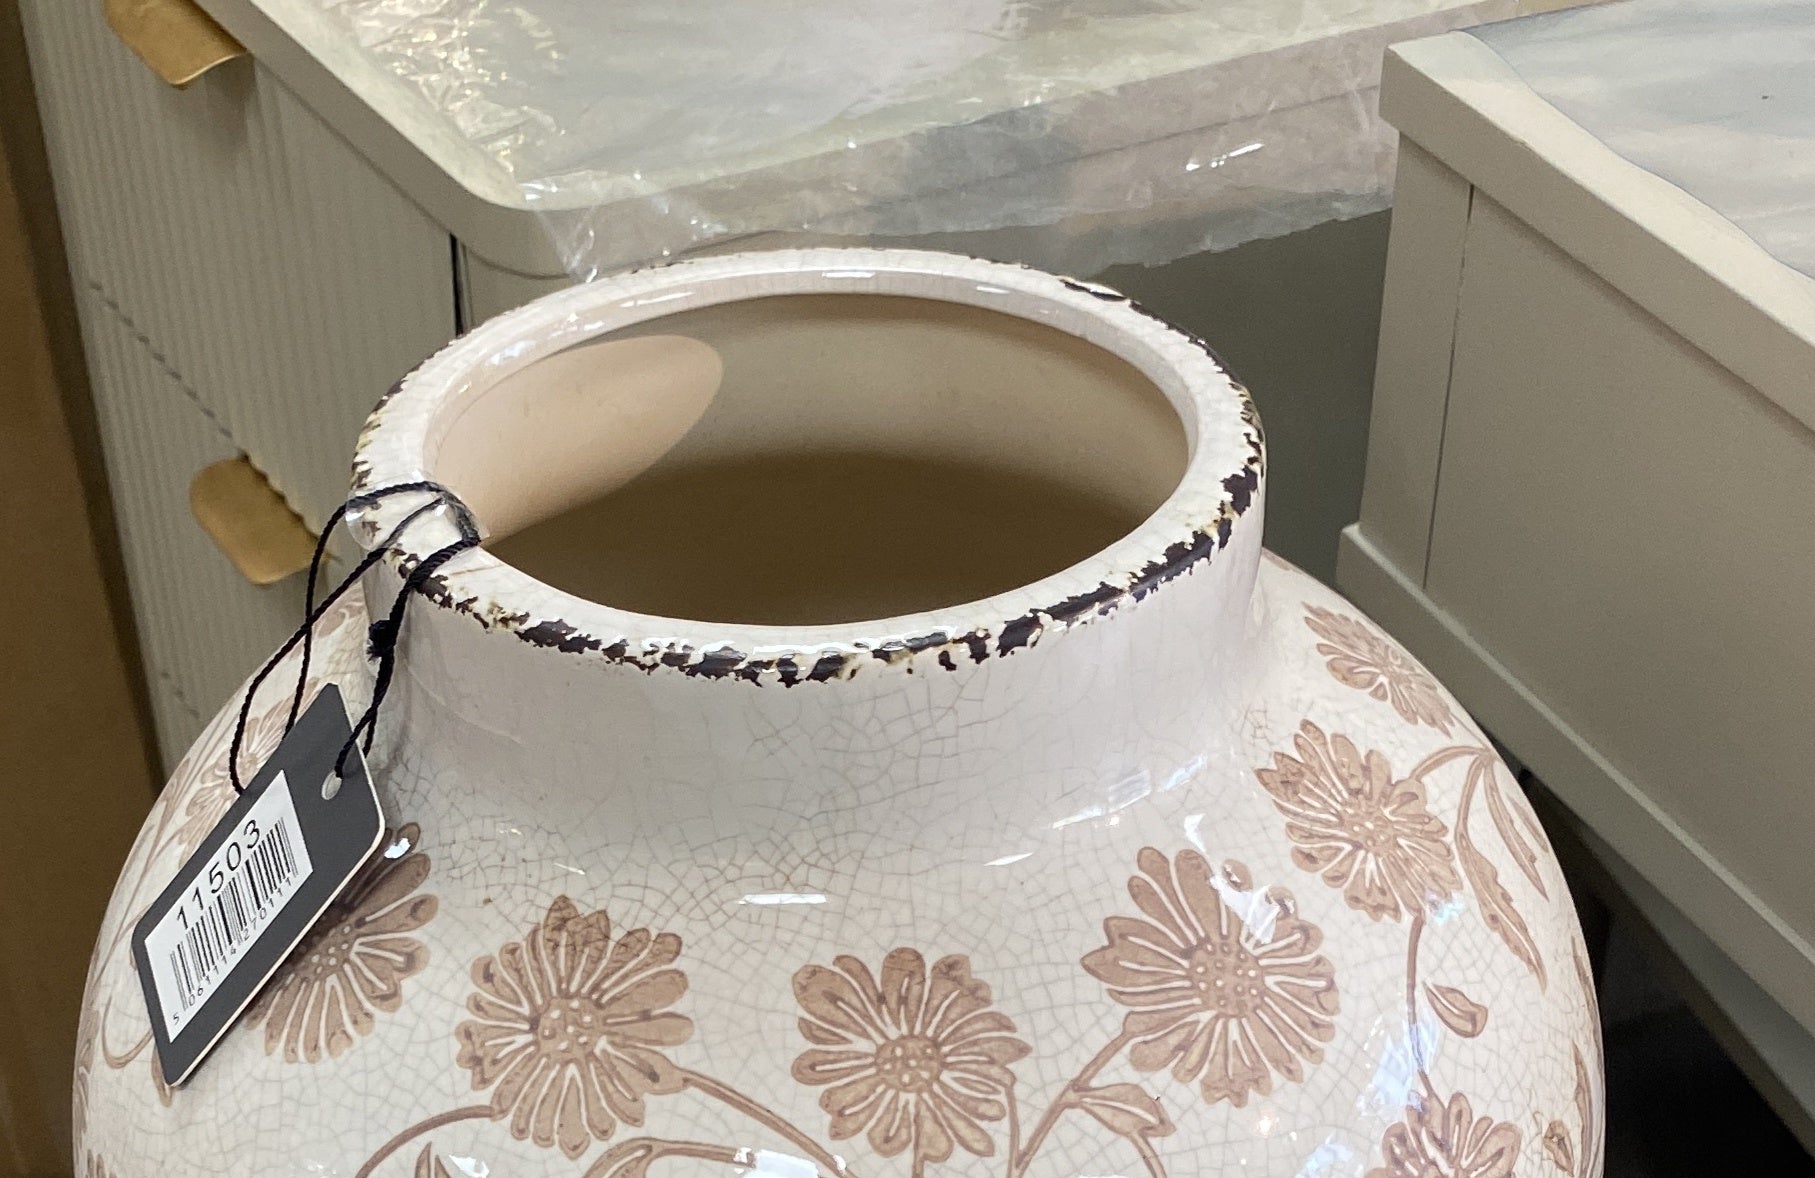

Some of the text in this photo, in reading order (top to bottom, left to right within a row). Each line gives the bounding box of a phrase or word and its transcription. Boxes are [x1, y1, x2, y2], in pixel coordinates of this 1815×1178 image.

[177, 819, 260, 930] 11503
[173, 1012, 180, 1026] 5
[242, 877, 292, 941] 270111
